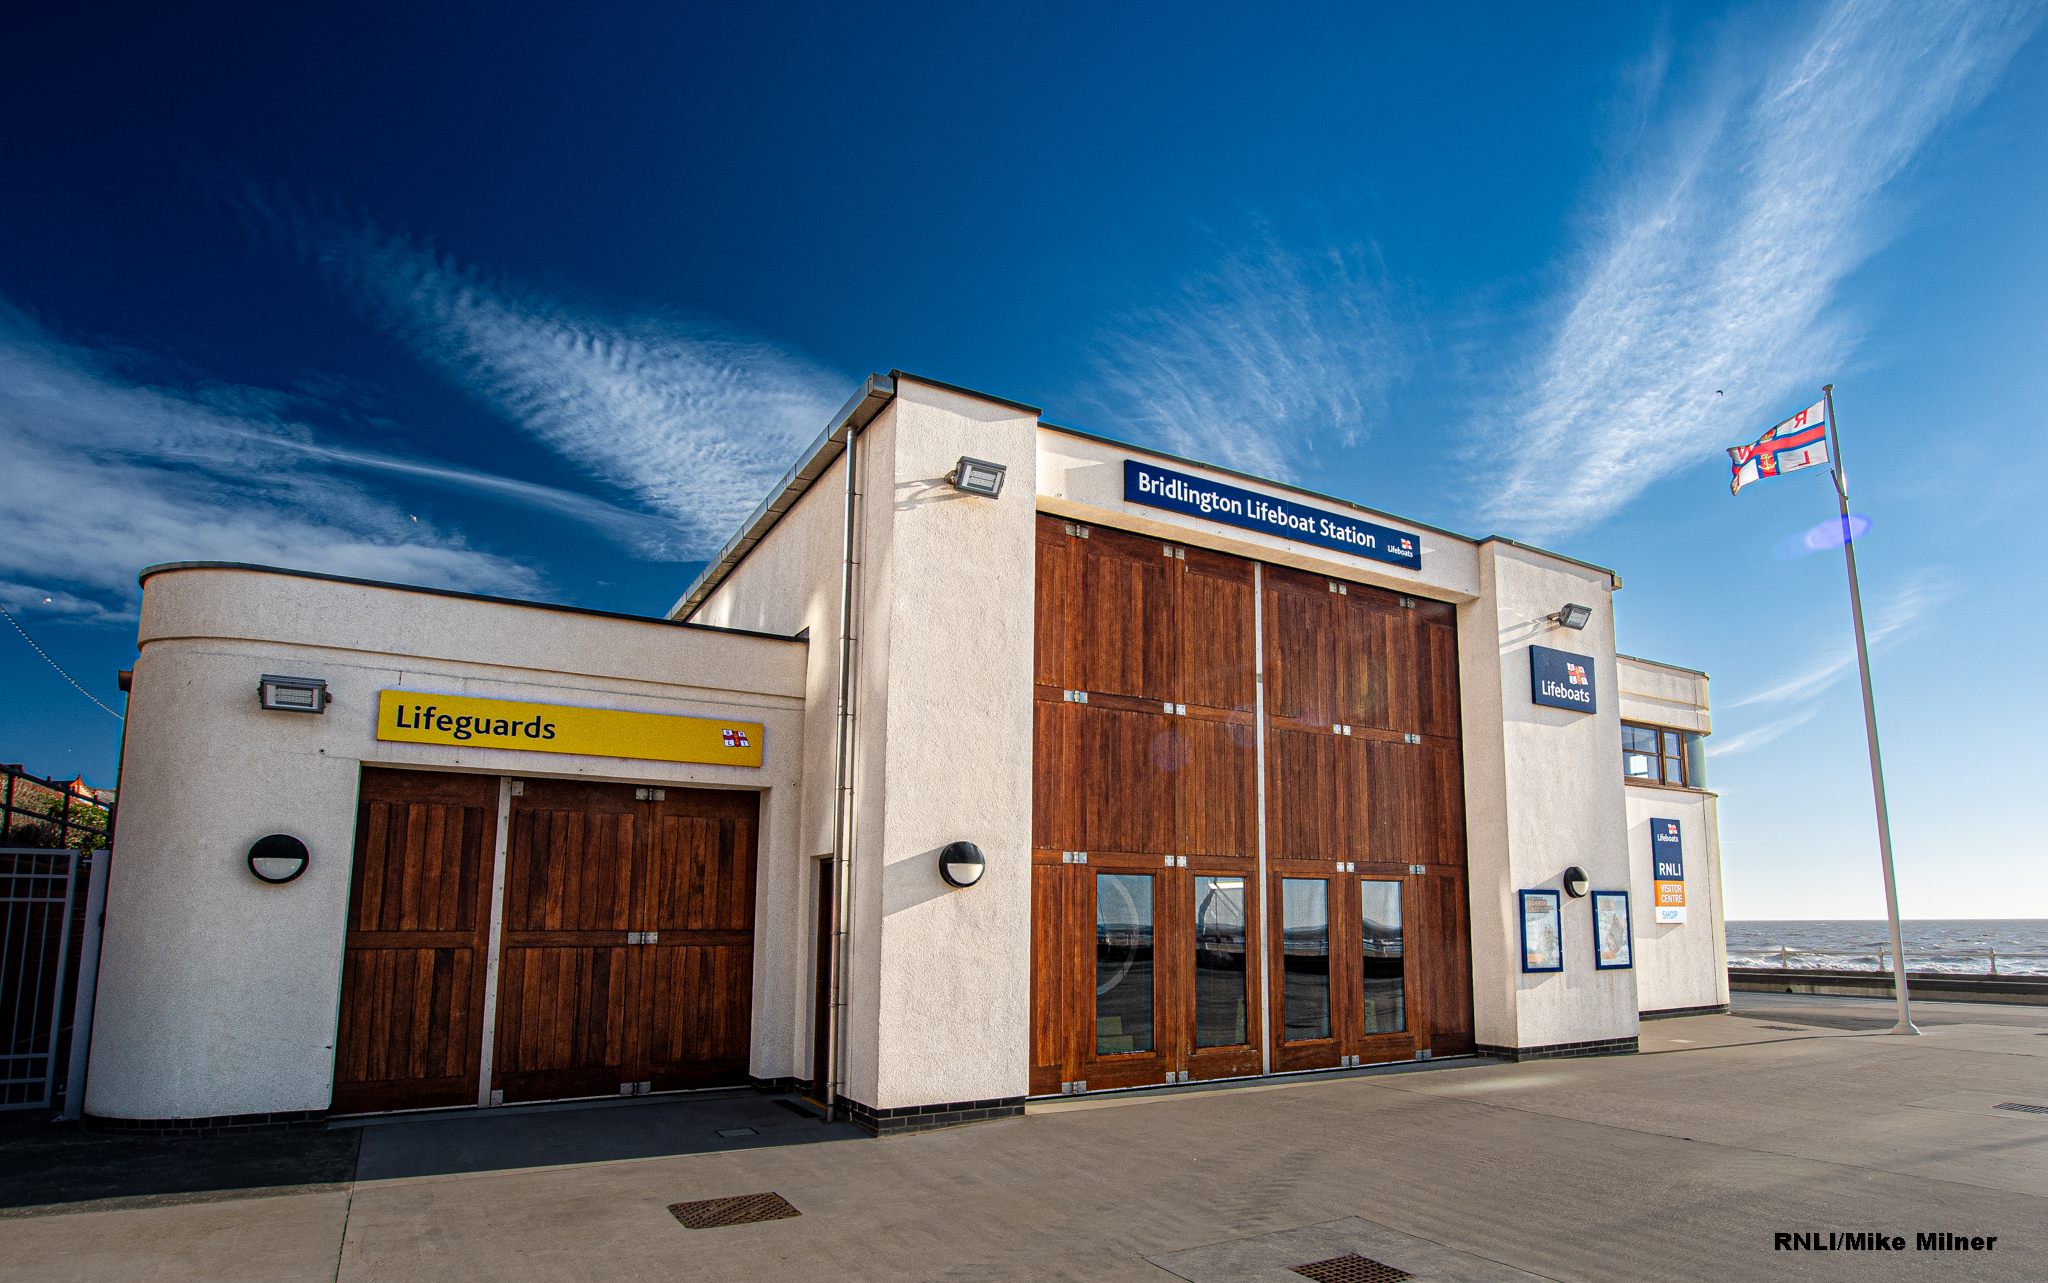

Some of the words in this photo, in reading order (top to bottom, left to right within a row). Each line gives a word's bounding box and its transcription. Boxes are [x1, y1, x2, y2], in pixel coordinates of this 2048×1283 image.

[1138, 471, 1242, 515] Bridlington
[1247, 499, 1316, 534] Lifeboat
[1320, 518, 1376, 549] Station
[1387, 544, 1414, 558] Lifeboats
[1541, 680, 1591, 703] Lifeboats
[395, 704, 557, 740] Lifeguards
[1657, 833, 1679, 843] Lifeboats
[1659, 862, 1682, 876] RNLI
[1660, 884, 1682, 893] VISITOR
[1661, 894, 1683, 903] CENTRE
[1662, 910, 1678, 919] SHOP
